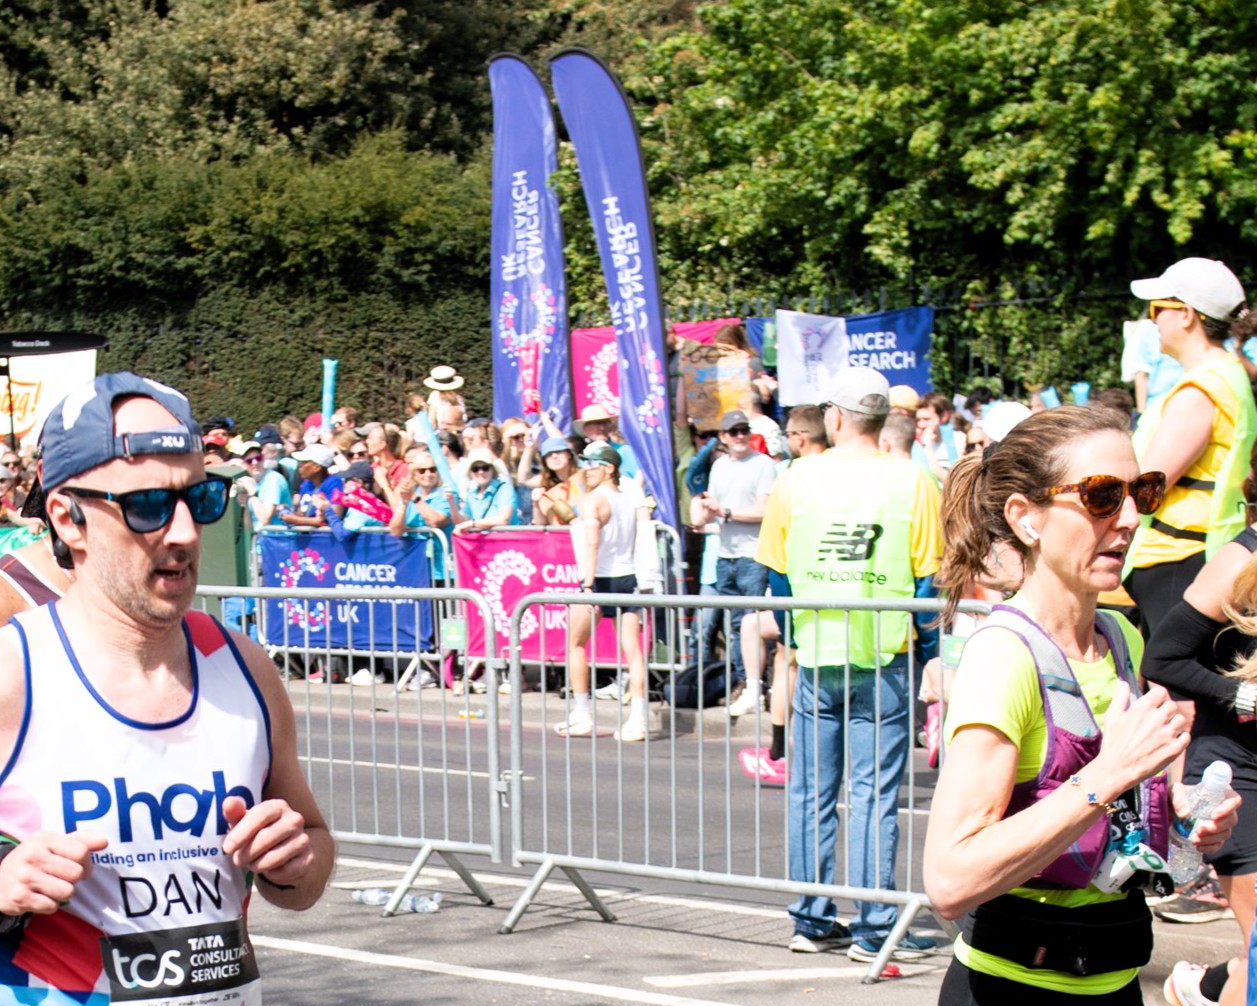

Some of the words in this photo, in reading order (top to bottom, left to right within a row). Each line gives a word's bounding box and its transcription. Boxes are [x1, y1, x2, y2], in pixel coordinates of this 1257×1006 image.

[847, 331, 897, 351] ANCER
[849, 351, 916, 370] SEARCH
[334, 562, 397, 582] CANCER
[542, 564, 579, 583] CAN
[829, 568, 887, 585] balace
[545, 609, 567, 629] UK
[91, 851, 134, 867] ilding
[137, 851, 156, 863] an
[119, 869, 224, 918] DAN
[112, 947, 186, 990] tcs
[188, 934, 225, 951] TATA
[190, 943, 250, 967] CONSULTA
[191, 963, 241, 983] SERVICES
